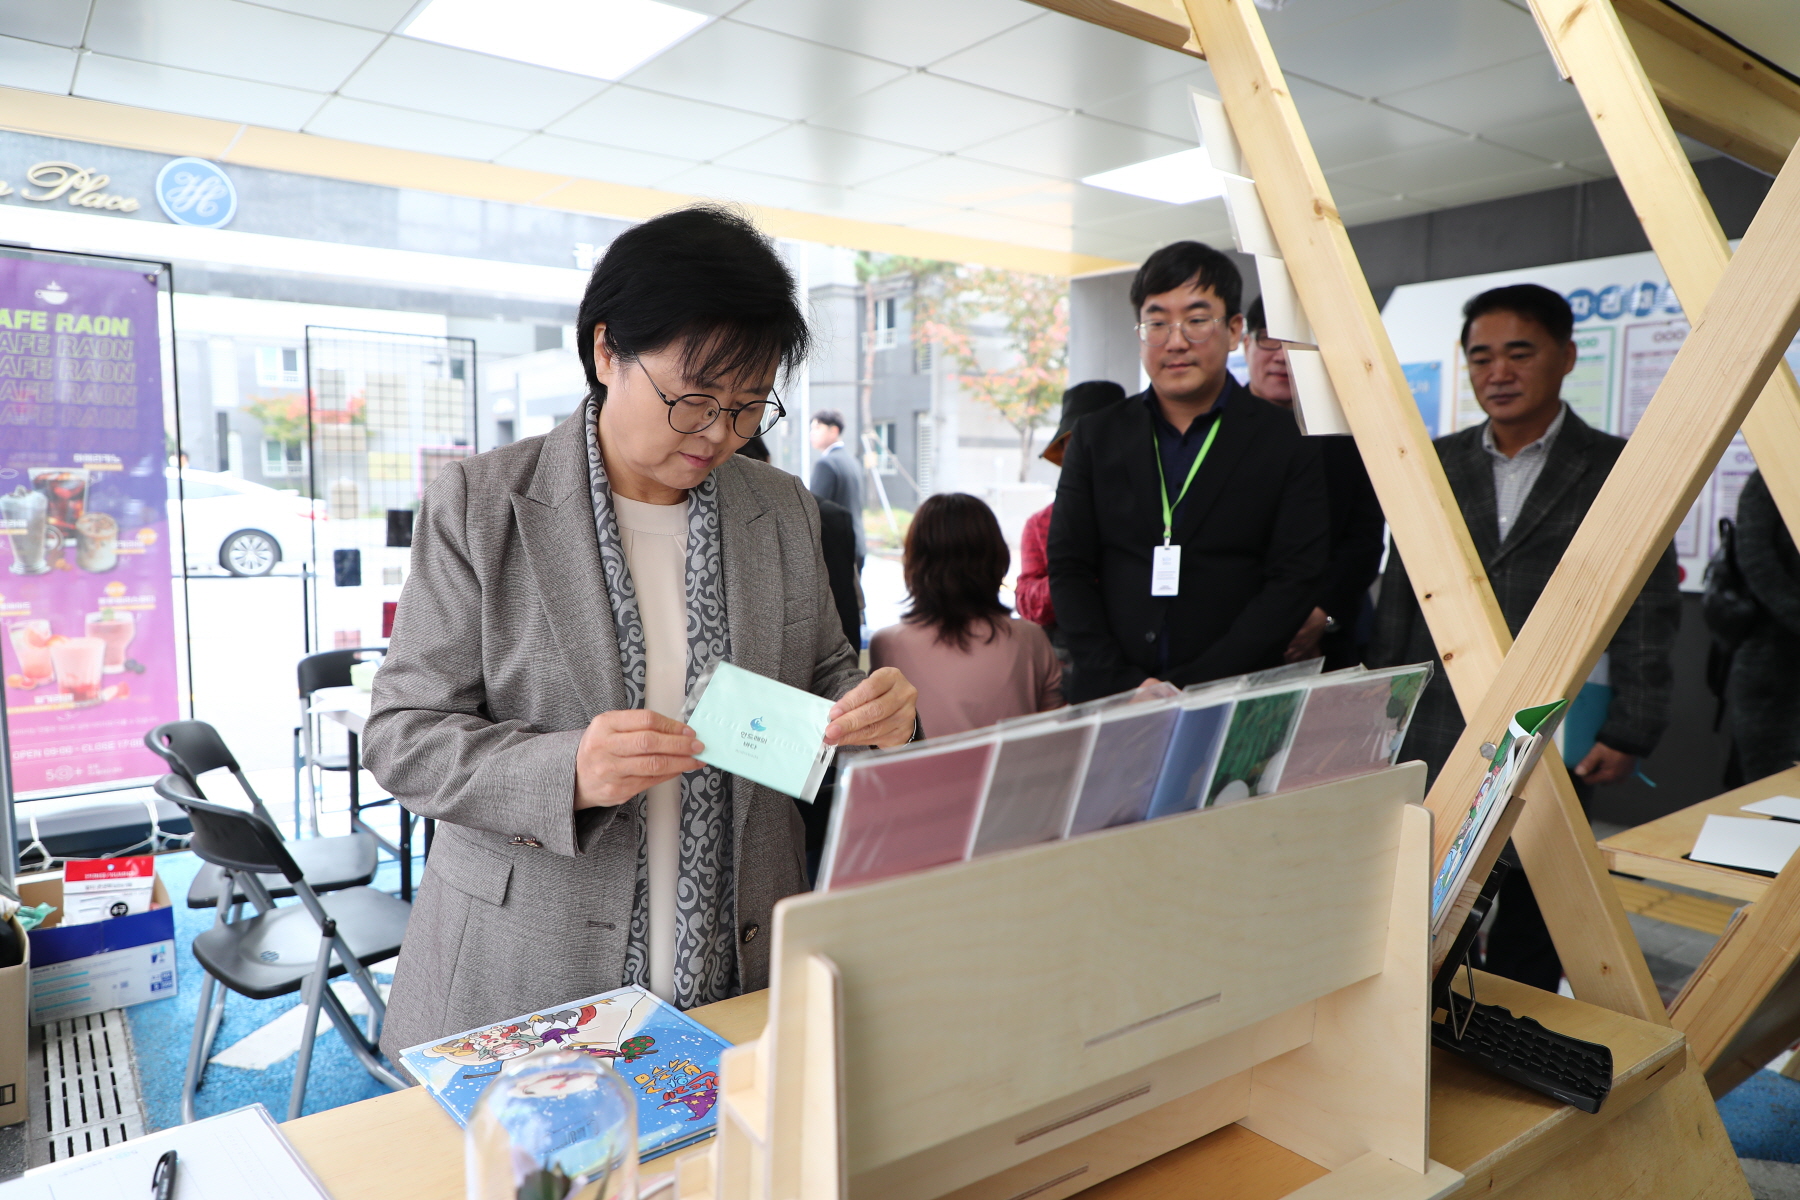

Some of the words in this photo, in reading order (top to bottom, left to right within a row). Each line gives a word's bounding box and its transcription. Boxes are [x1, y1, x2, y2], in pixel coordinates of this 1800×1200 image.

[21, 161, 141, 213] Place
[55, 313, 130, 337] RAON
[56, 335, 134, 361] RAON
[59, 359, 137, 384] RAON
[60, 382, 138, 407] RAON
[61, 406, 138, 430] RAON
[12, 749, 42, 761] OPEN
[81, 740, 116, 753] CLOSE
